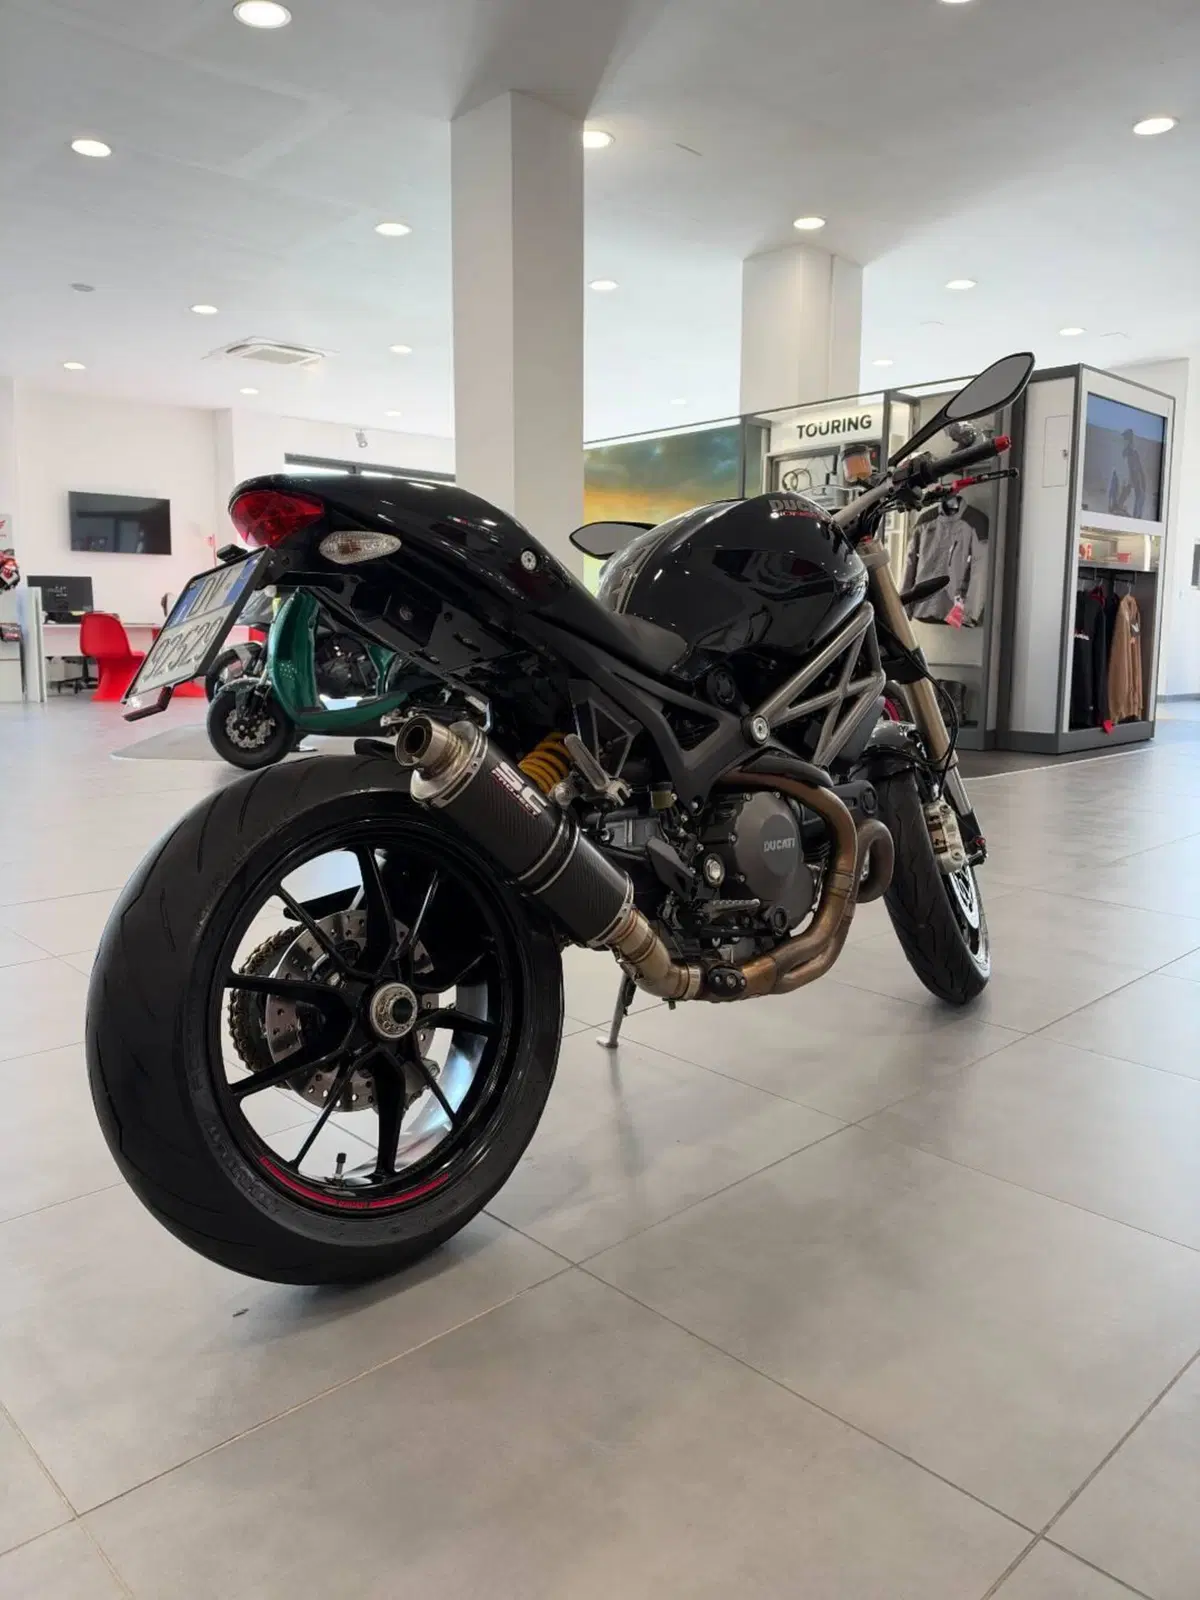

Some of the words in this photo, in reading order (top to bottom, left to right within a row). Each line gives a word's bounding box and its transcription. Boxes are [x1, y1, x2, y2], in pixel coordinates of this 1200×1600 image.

[796, 414, 872, 439] TOURING
[187, 567, 233, 617] DV
[142, 616, 224, 683] 92529
[491, 769, 537, 816] PROJECT
[495, 761, 547, 814] SC
[763, 837, 796, 852] DUCATI
